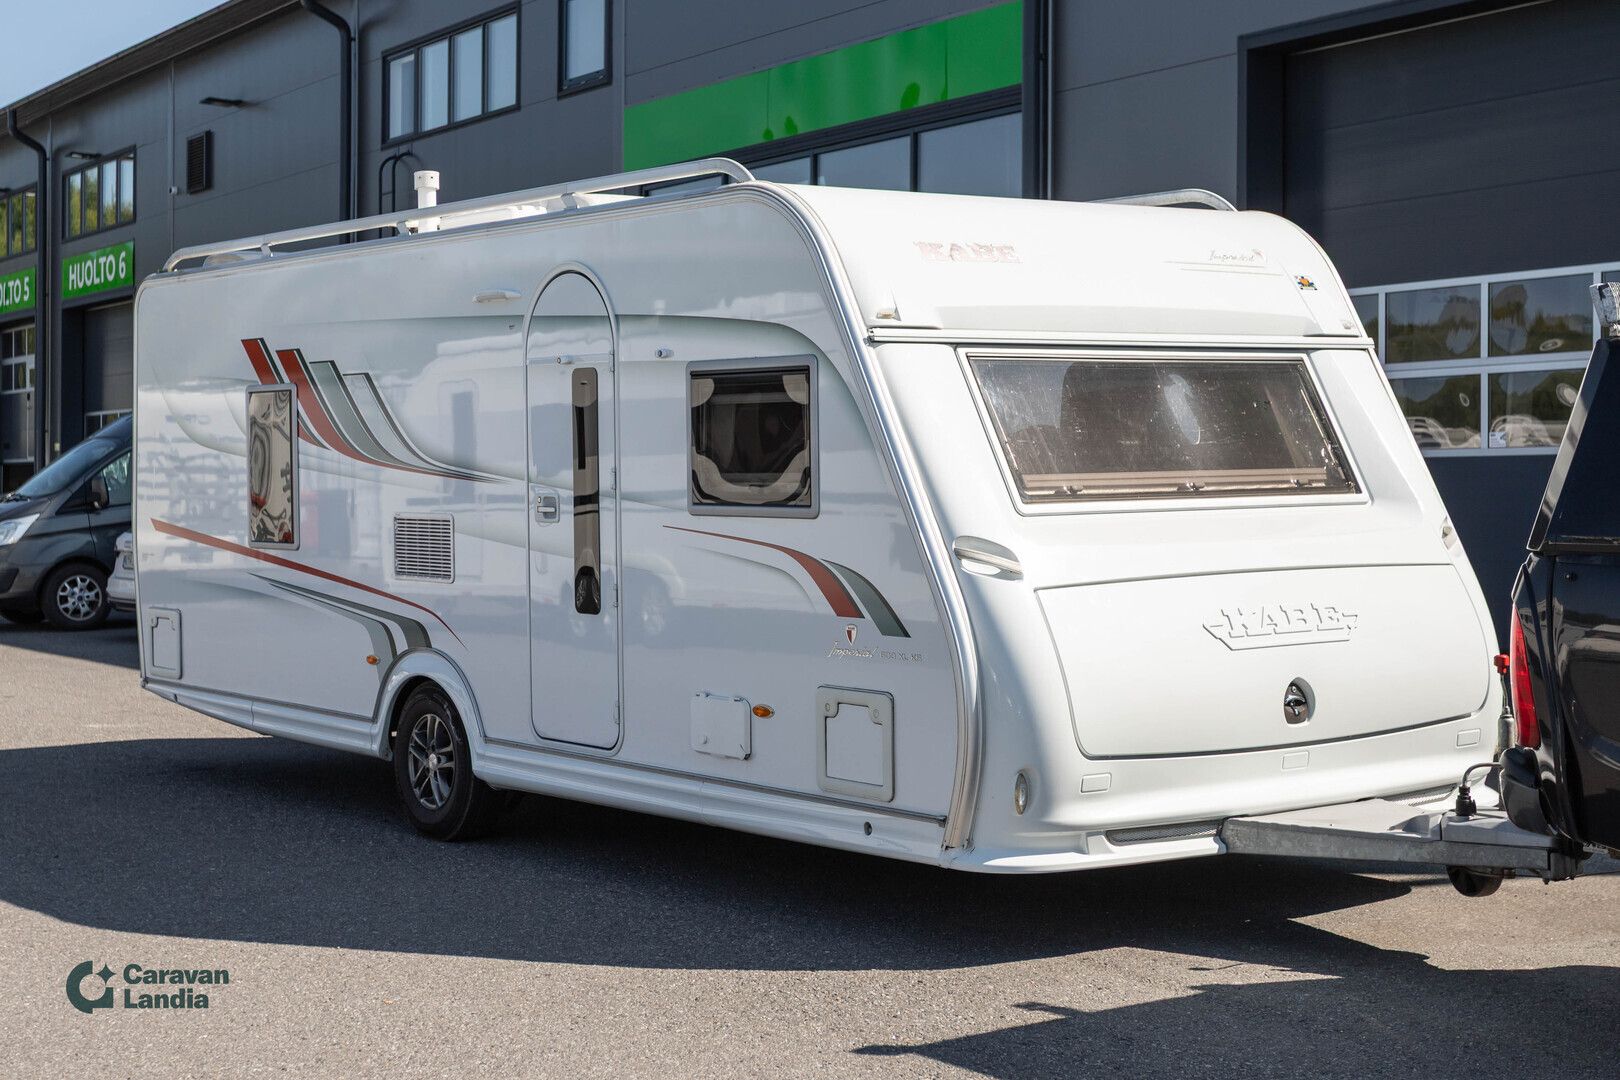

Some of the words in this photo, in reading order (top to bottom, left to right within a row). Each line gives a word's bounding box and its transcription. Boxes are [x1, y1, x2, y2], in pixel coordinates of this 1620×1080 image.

[68, 253, 116, 291] HUOLTO
[118, 251, 126, 279] 6
[23, 276, 30, 302] 5
[827, 640, 879, 662] Imperial
